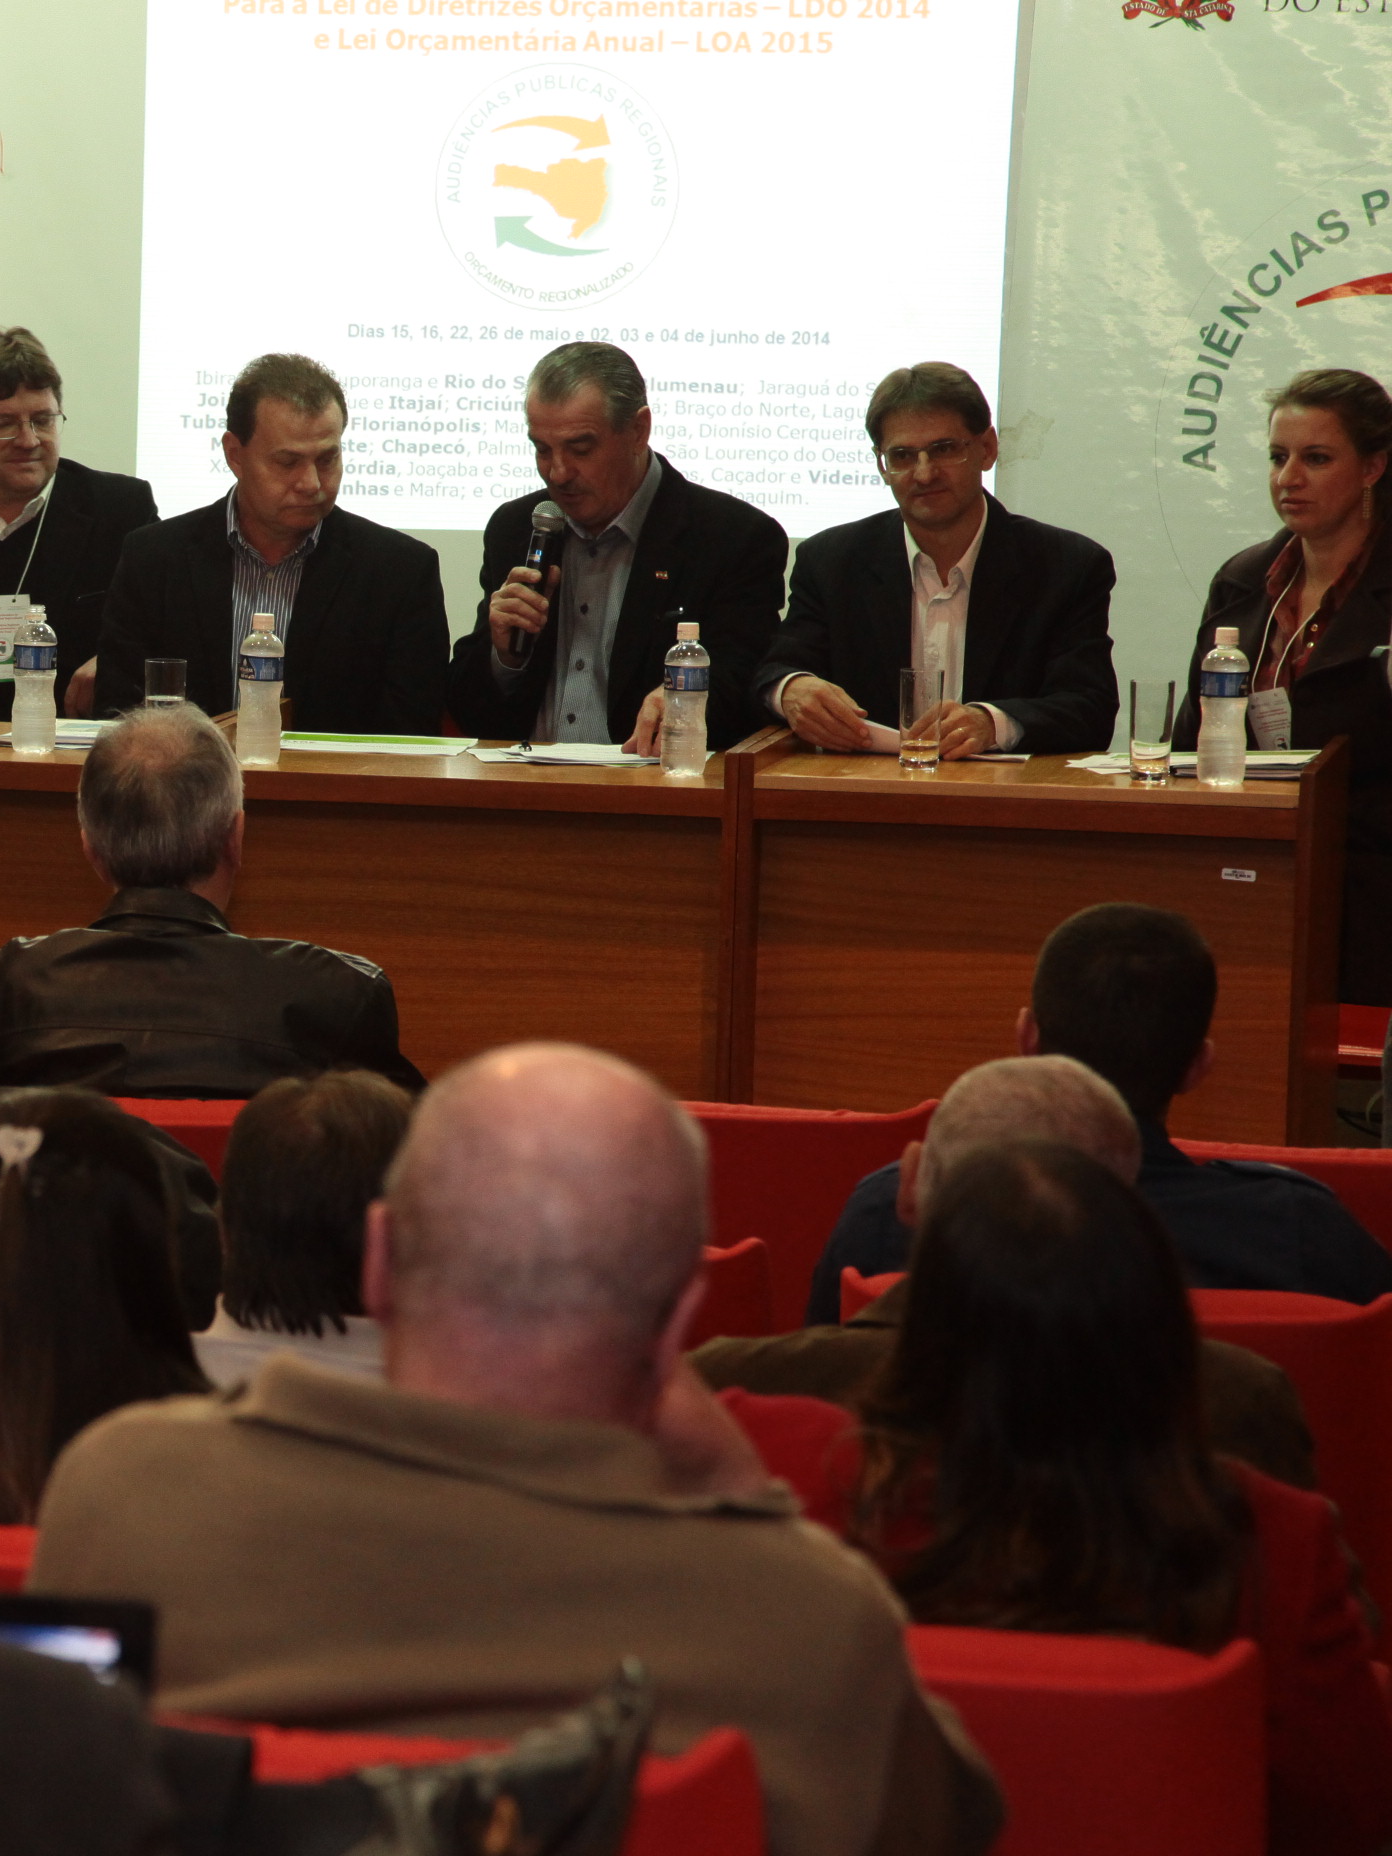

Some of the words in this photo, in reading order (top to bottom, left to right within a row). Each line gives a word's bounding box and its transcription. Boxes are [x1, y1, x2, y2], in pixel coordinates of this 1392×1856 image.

[365, 0, 398, 15] de
[788, 0, 848, 18] LDO
[857, 0, 930, 19] 2014
[313, 32, 330, 50] e
[338, 28, 377, 51] Lei
[385, 27, 577, 57] Orçamentária
[582, 29, 664, 53] Anual
[696, 31, 753, 53] LOA
[760, 31, 834, 54] 2015
[619, 97, 668, 208] REGIONAIS
[348, 324, 385, 339] Dias
[392, 325, 413, 341] 15,
[420, 325, 443, 342] 16,
[450, 325, 473, 342] 22,
[479, 326, 498, 340] 26
[504, 326, 524, 341] de
[529, 327, 571, 341] maio
[575, 331, 585, 341] e
[591, 328, 613, 343] 02,
[620, 328, 639, 342] 03
[645, 332, 655, 342] e
[660, 329, 679, 343] 04
[685, 329, 705, 343] de
[709, 329, 760, 347] junho
[765, 331, 786, 344] de
[792, 331, 831, 345] 2014
[1181, 207, 1351, 473] AUDIÊNCIAS
[427, 377, 438, 389] e
[444, 374, 476, 389] Rio
[481, 375, 507, 390] do
[757, 378, 830, 399] Jaraguá
[836, 380, 860, 397] do
[389, 394, 450, 413] Itajaí;
[675, 399, 727, 419] Braço
[731, 401, 754, 417] do
[759, 402, 816, 420] Norte,
[351, 415, 488, 436] Florianópolis;
[699, 421, 772, 440] Dionísio
[776, 424, 866, 443] Cerqueira
[665, 443, 699, 461] São
[705, 445, 789, 465] Lourenço
[793, 446, 816, 463] do
[406, 462, 479, 480] Joaçaba
[483, 465, 494, 478] e
[711, 466, 786, 486] Caçador
[790, 472, 802, 484] e
[394, 484, 404, 496] e
[472, 486, 483, 498] e
